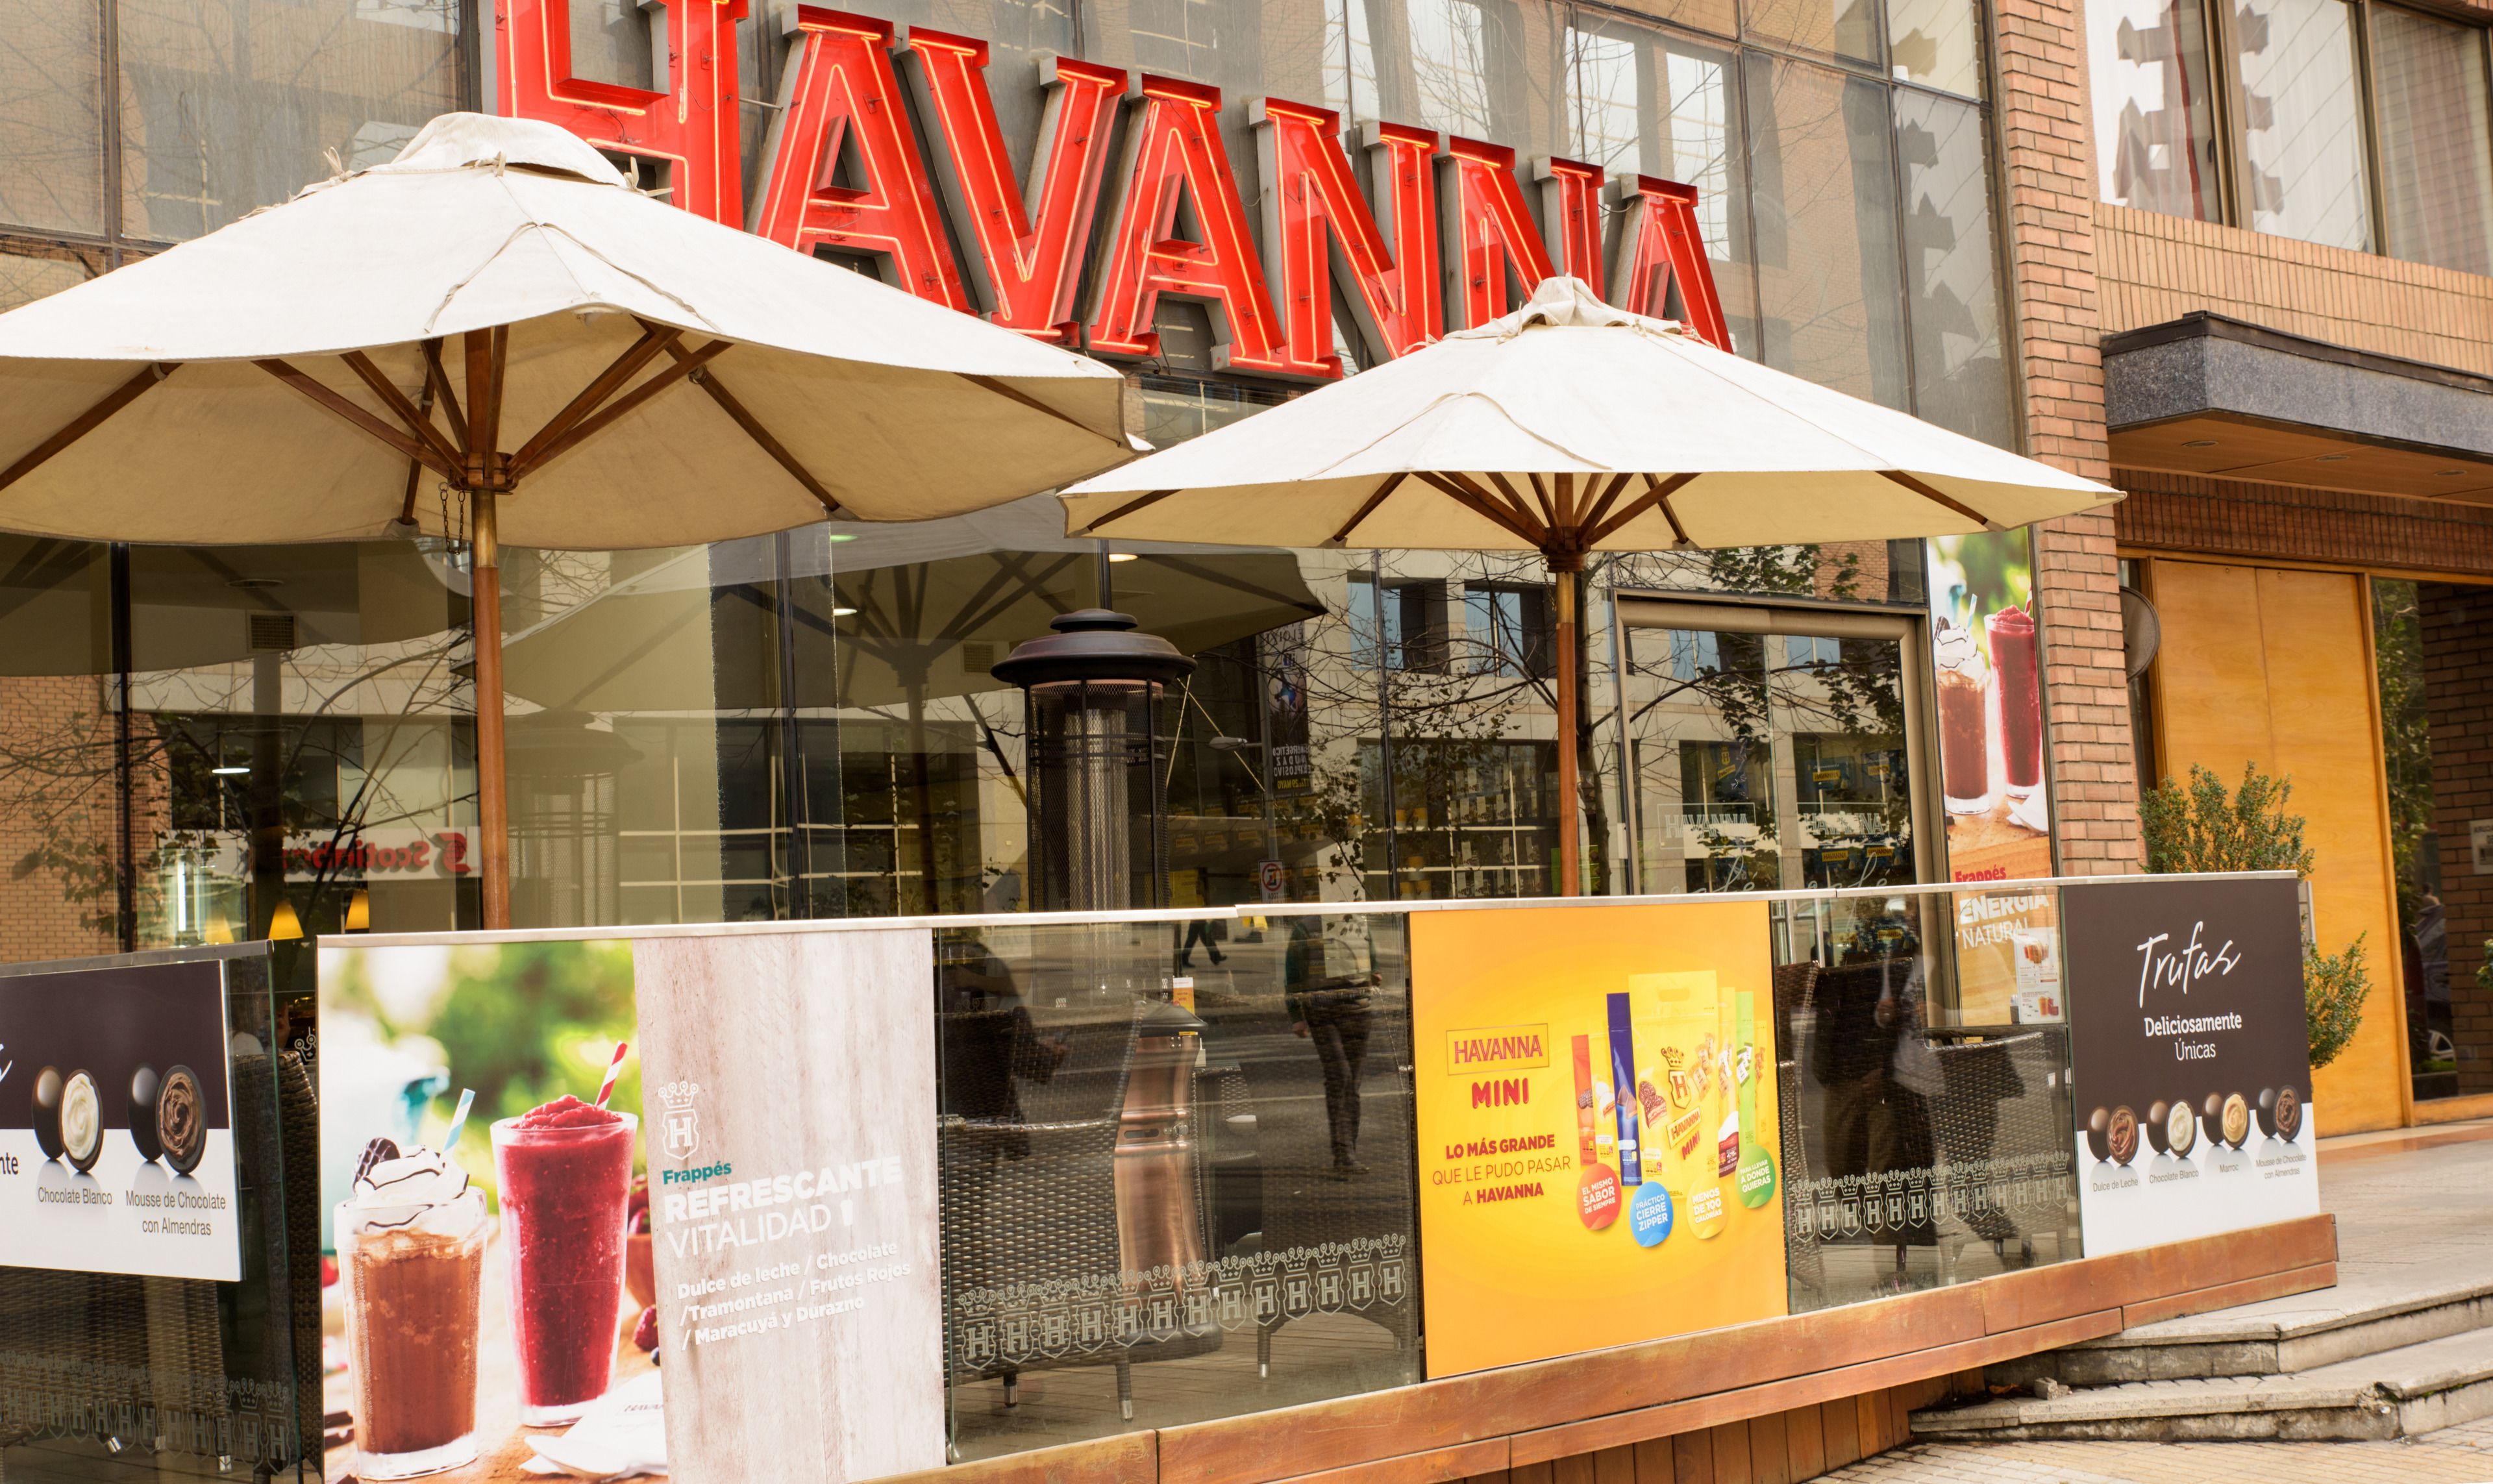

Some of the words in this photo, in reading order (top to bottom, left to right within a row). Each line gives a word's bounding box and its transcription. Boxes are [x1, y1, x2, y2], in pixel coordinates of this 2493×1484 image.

[495, 0, 1736, 380] HAVANNA
[1804, 812, 1885, 835] HANA
[1955, 865, 2006, 882] Frappés
[2137, 921, 2240, 1008] Trufas
[2144, 1011, 2242, 1037] Deliciosamente
[1454, 1035, 1543, 1065] HAVANNA
[2175, 1038, 2216, 1061] Únicas
[1471, 1077, 1529, 1109] MINI
[669, 1117, 693, 1149] H
[1670, 1111, 1701, 1141] HAVANNA
[1446, 1143, 1464, 1159] LO
[1467, 1135, 1498, 1156] MÁS
[1500, 1133, 1555, 1153] GRANDE
[1681, 1132, 1701, 1159] MINI
[1432, 1169, 1462, 1185] QUE
[1466, 1167, 1482, 1181] LE
[1485, 1162, 1524, 1179] PUDO
[1528, 1156, 1570, 1174] PASAR
[2219, 1163, 2239, 1173] Marroc
[2256, 1158, 2274, 1168] Mousse
[2276, 1157, 2283, 1165] de
[2283, 1154, 2307, 1165] Chocolate
[663, 1161, 732, 1185] Frappés
[1741, 1174, 1747, 1183] A
[1748, 1167, 1770, 1181] DONDE
[1742, 1175, 1771, 1193] QUIERAS
[2149, 1171, 2178, 1184] Chocolate
[2180, 1169, 2199, 1180] Blanco
[2264, 1170, 2273, 1179] con
[2274, 1167, 2300, 1178] Almendras
[664, 1155, 903, 1223] REFRESCANTE
[1463, 1191, 1472, 1205] A
[1476, 1182, 1544, 1204] HAVANNA
[1582, 1186, 1590, 1196] EL
[1591, 1177, 1613, 1193] MISMO
[2093, 1180, 2110, 1193] Dulce
[2112, 1179, 2119, 1190] de
[2121, 1176, 2138, 1189] Leche
[38, 1187, 81, 1204] Chocolate
[83, 1188, 112, 1205] Blanco
[126, 1190, 161, 1207] Mousse
[164, 1191, 175, 1207] de
[178, 1192, 226, 1209] Chocolate
[1583, 1187, 1616, 1206] SABOR
[1585, 1206, 1593, 1214] DE
[1594, 1196, 1616, 1212] SIEMPRE
[1636, 1192, 1665, 1211] PRÁCTICO
[1693, 1187, 1720, 1206] MENOS
[1693, 1203, 1704, 1215] DE
[1706, 1198, 1722, 1212] 100
[1637, 1201, 1667, 1222] CIERRE
[1638, 1212, 1668, 1232] ZIPPER
[142, 1219, 159, 1233] con
[162, 1217, 212, 1235] Almendras
[666, 1204, 832, 1259] VITALIDAD
[677, 1278, 726, 1299] Dulce
[730, 1272, 751, 1289] de
[755, 1261, 800, 1283] leche
[816, 1241, 898, 1270] Chocolate
[810, 1267, 863, 1297] Frutos
[867, 1263, 911, 1285] Rojos
[695, 1307, 778, 1344] Maracuyá
[781, 1311, 791, 1329] y
[797, 1297, 865, 1322] Durazno
